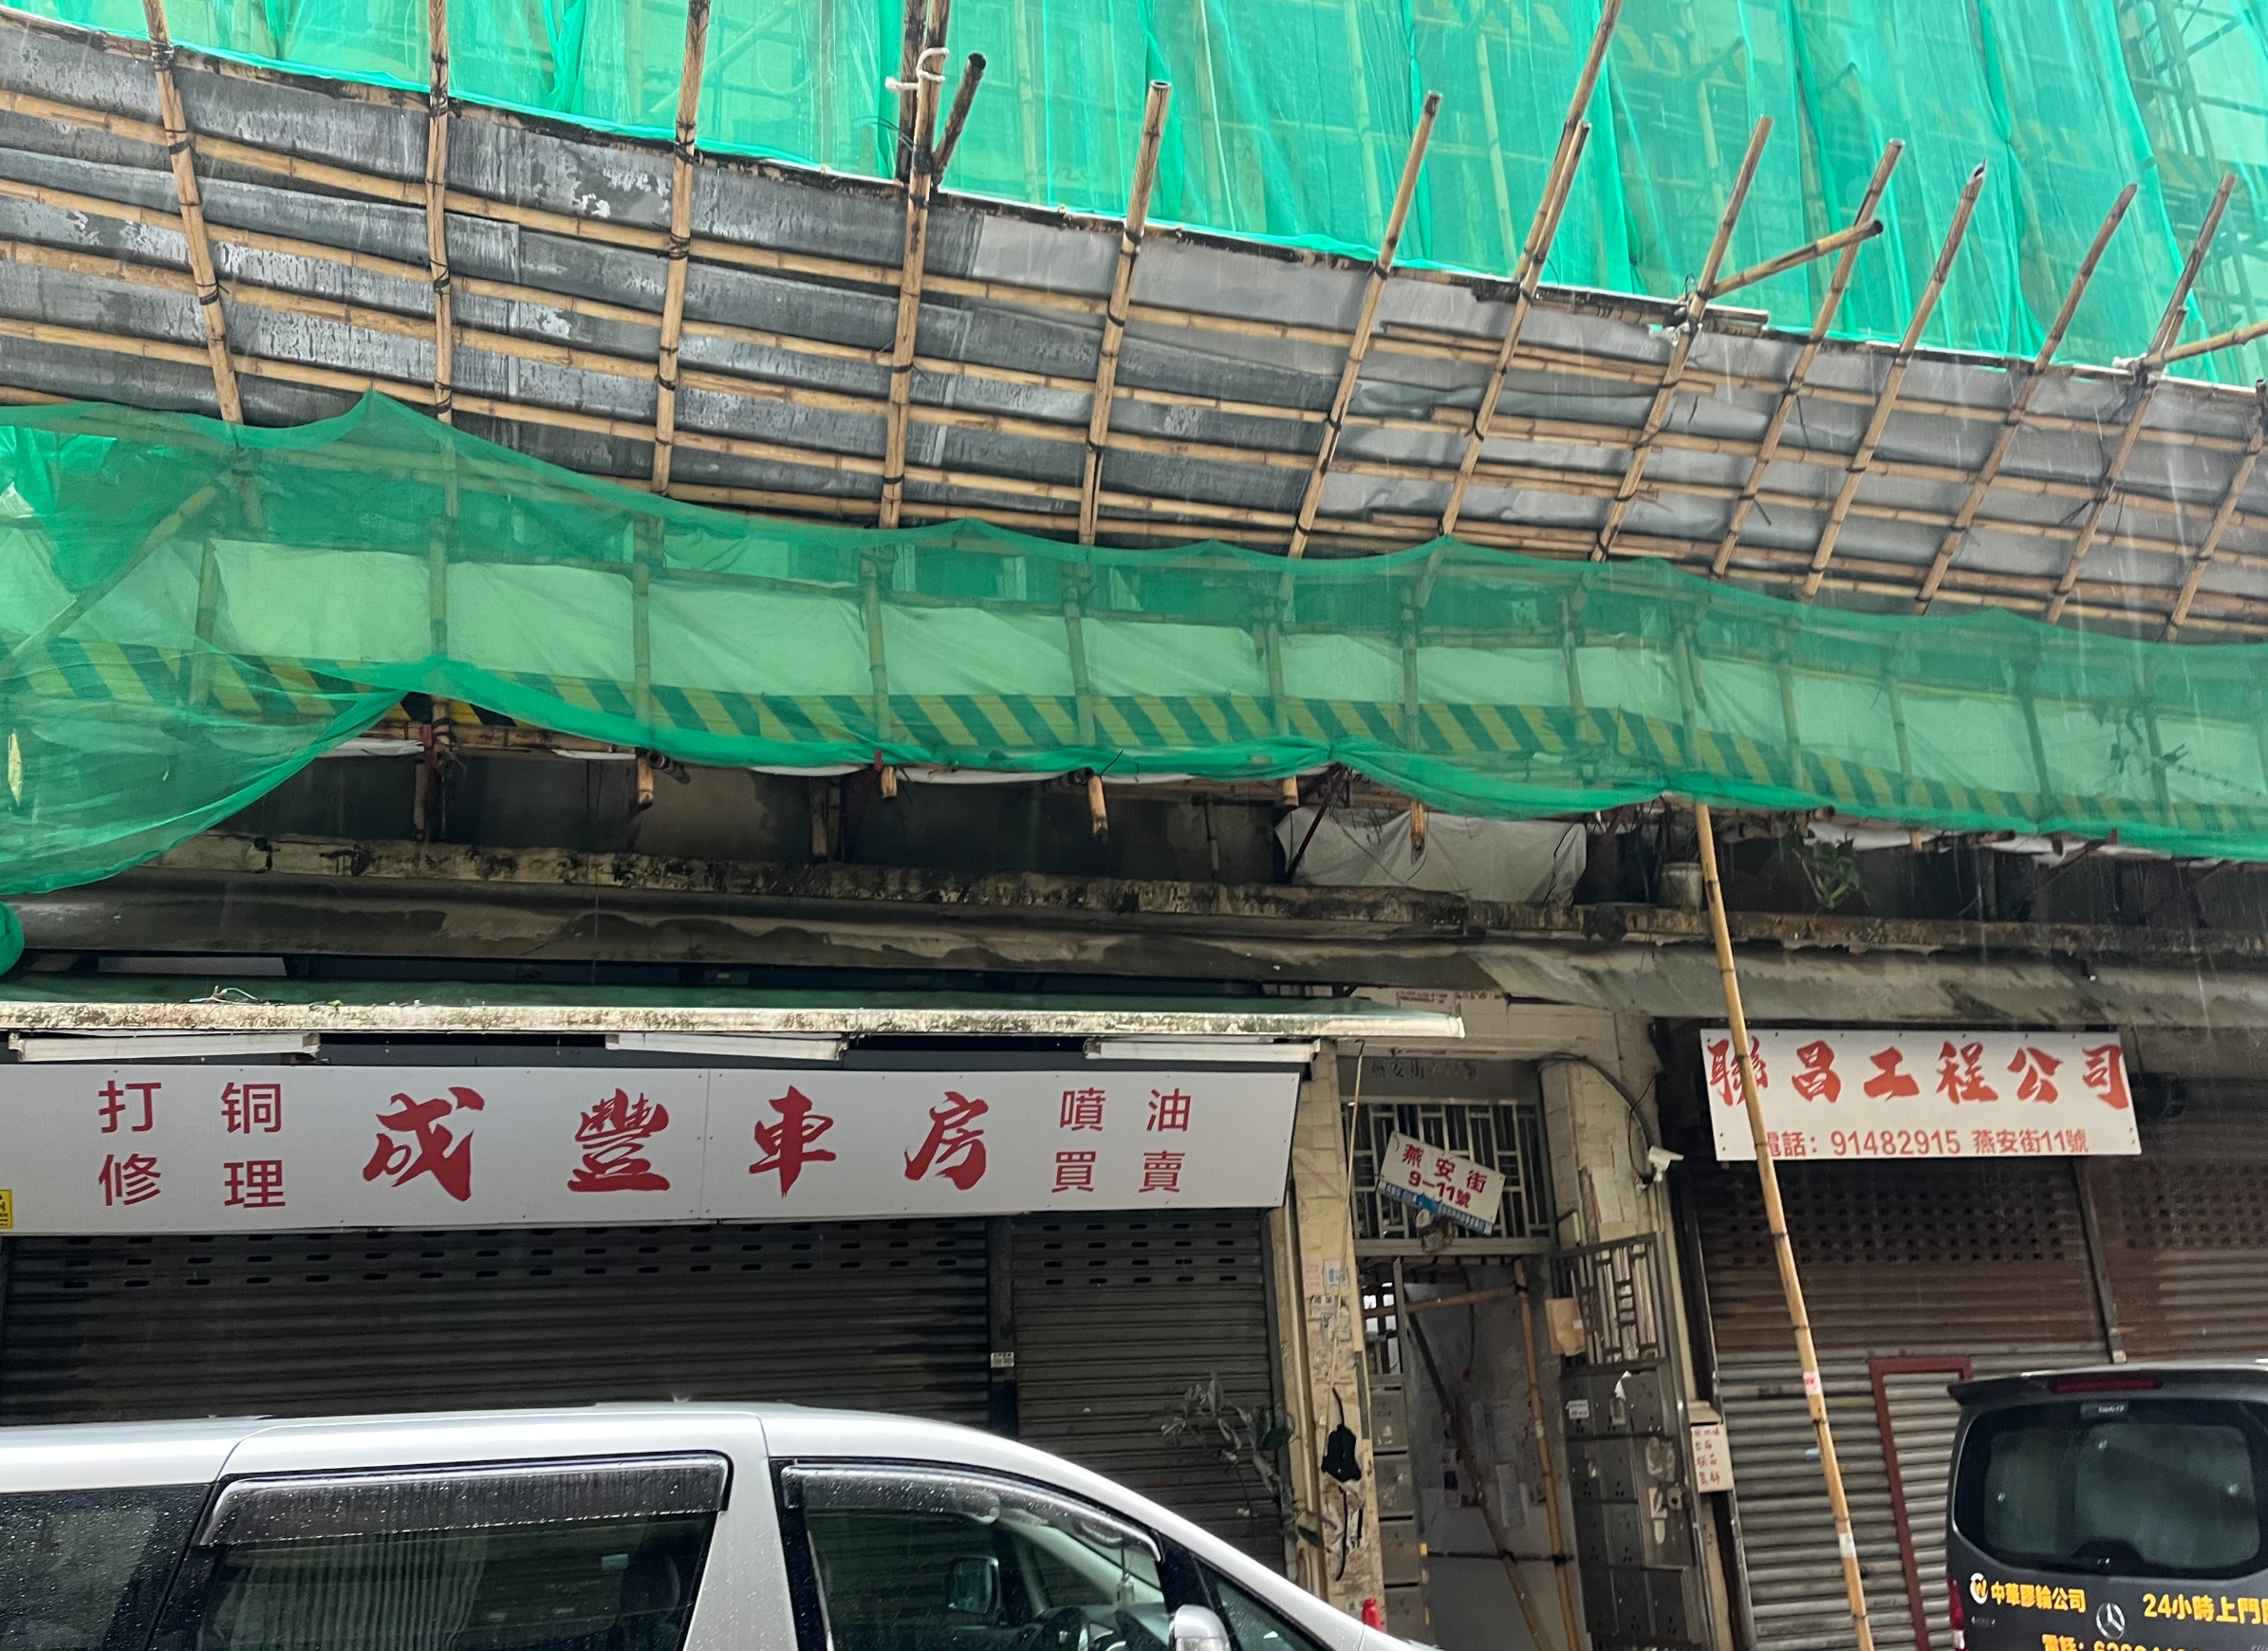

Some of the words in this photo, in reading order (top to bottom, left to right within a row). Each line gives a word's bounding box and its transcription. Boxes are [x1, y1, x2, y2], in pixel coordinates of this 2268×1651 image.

[1706, 1035, 2130, 1110] 聯昌工程公司
[98, 1080, 282, 1134] 打铜
[1059, 1086, 1192, 1132] 噴油
[363, 1085, 989, 1202] 成豐車房
[1830, 1128, 1961, 1156] 91482915
[1972, 1128, 2090, 1155] 燕安街11號
[98, 1153, 286, 1209] 修理
[1050, 1150, 1186, 1194] 買賣
[1401, 1143, 1488, 1196] 燕安街
